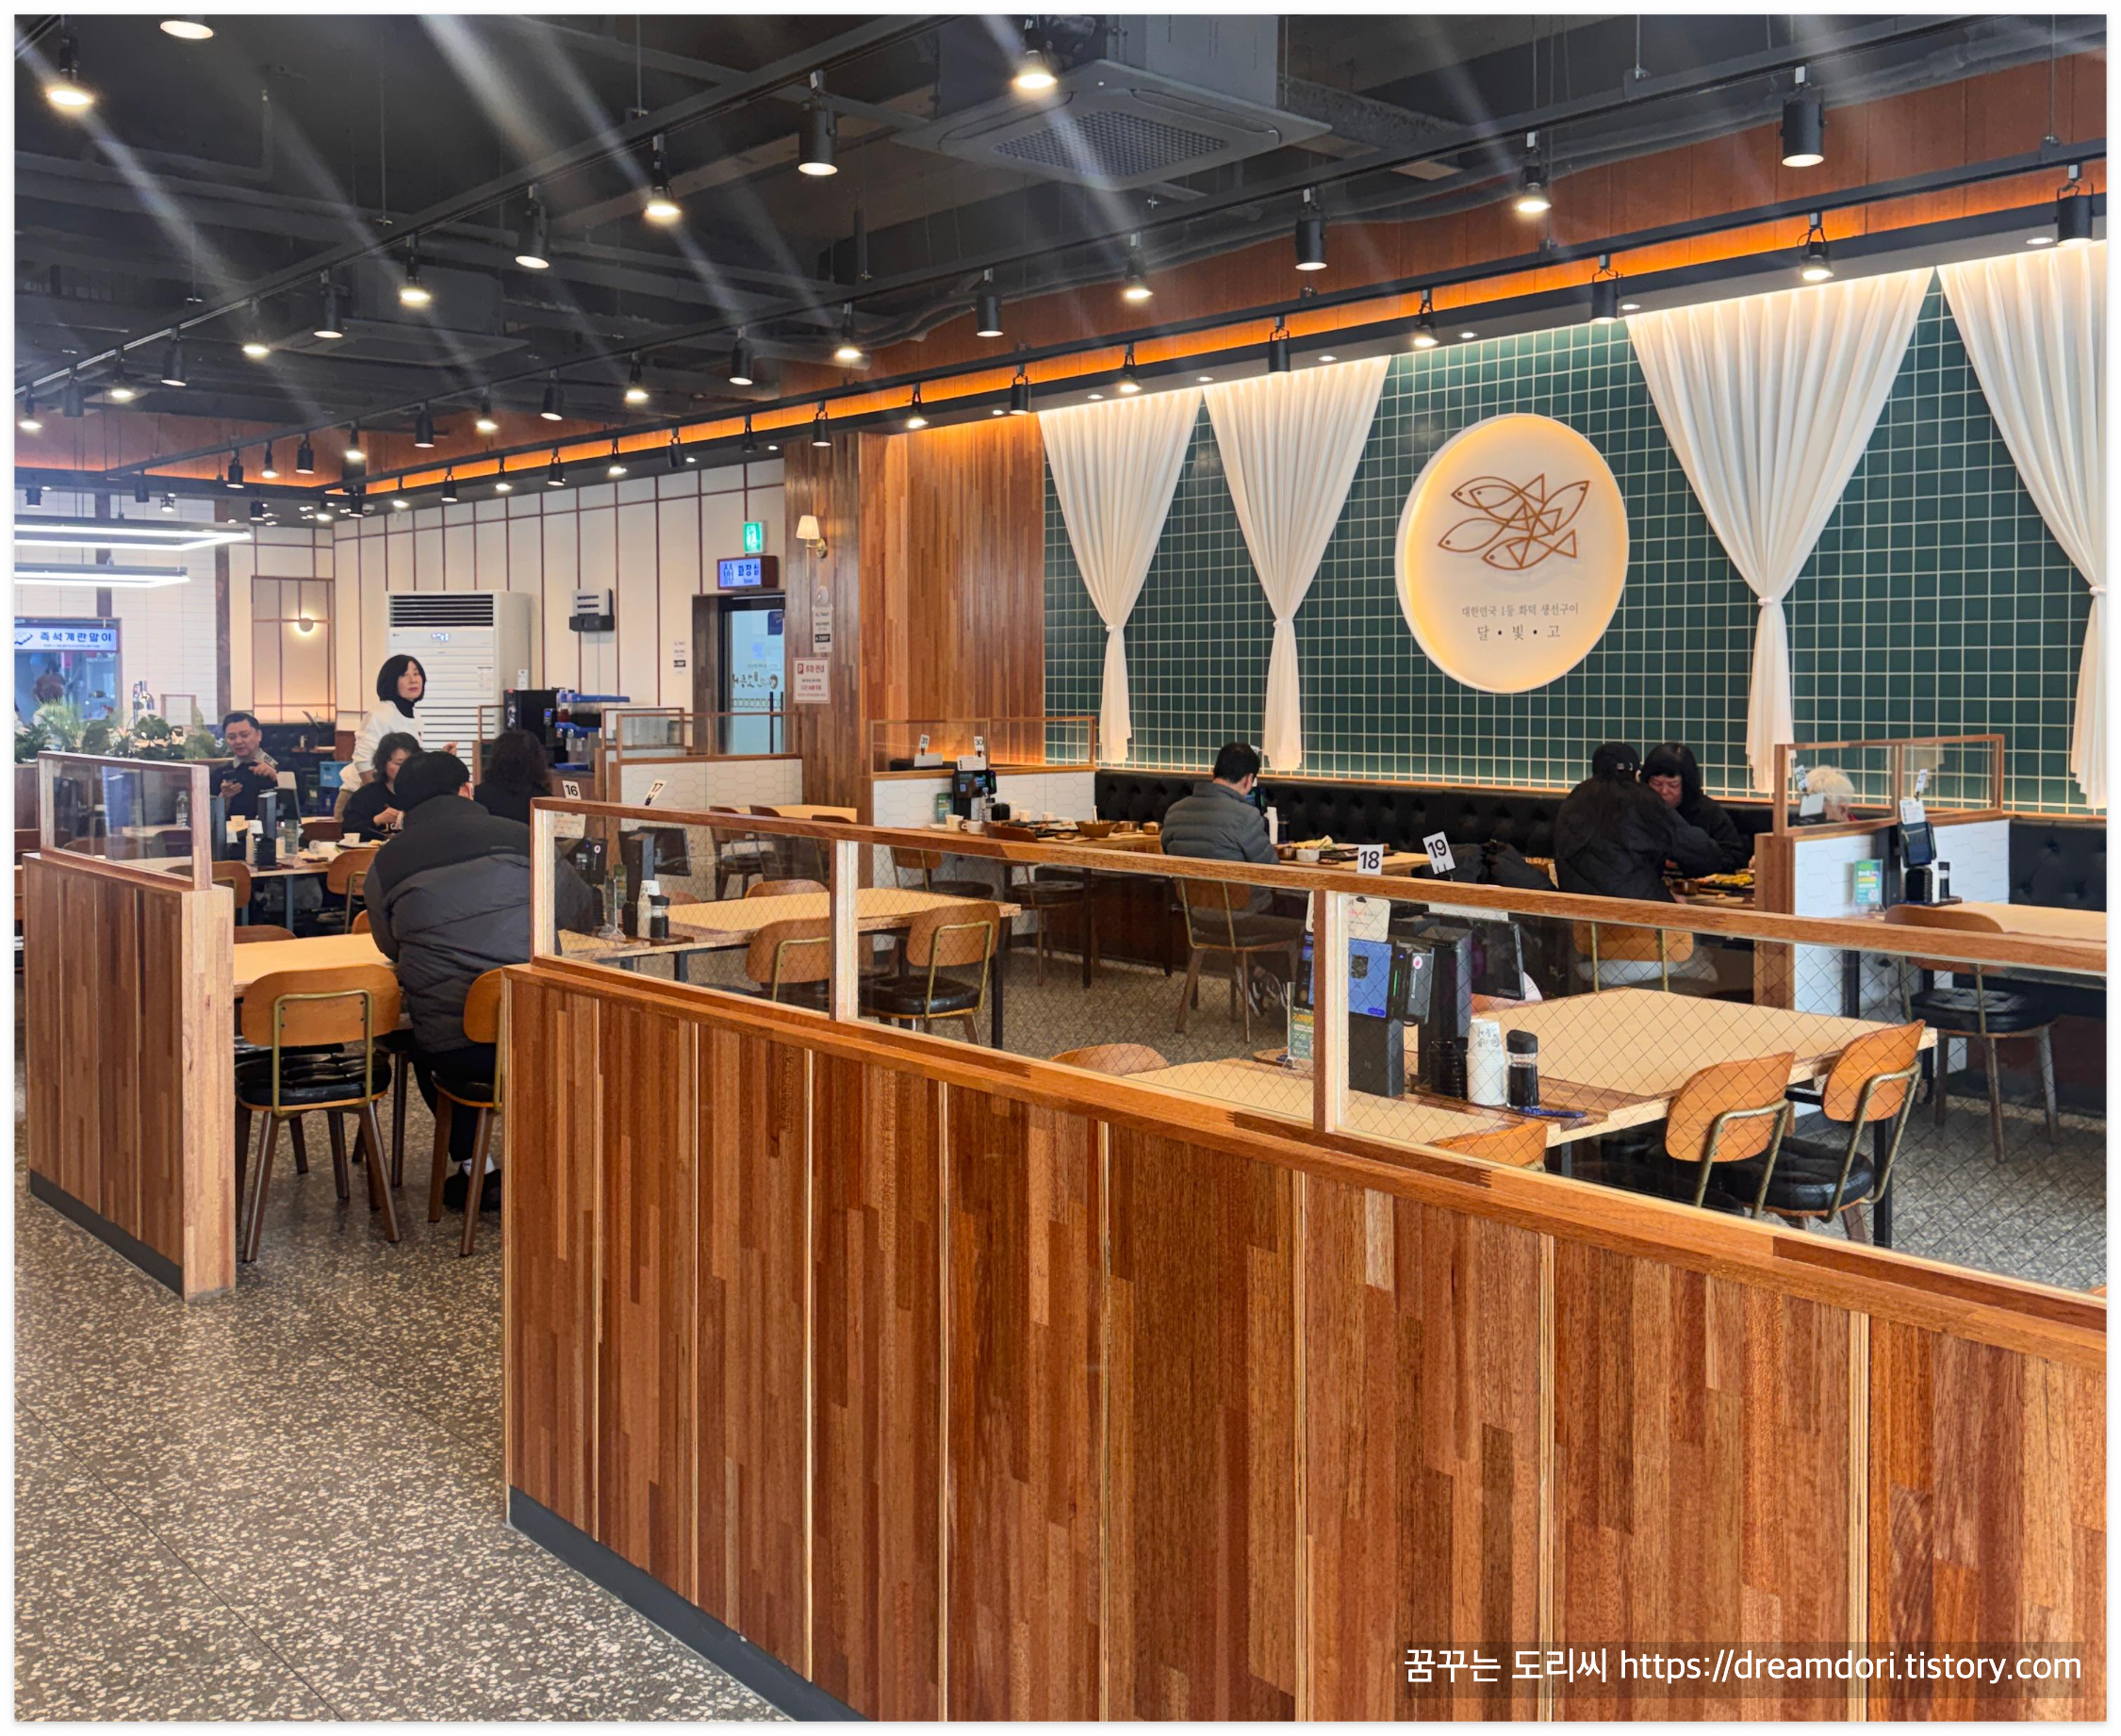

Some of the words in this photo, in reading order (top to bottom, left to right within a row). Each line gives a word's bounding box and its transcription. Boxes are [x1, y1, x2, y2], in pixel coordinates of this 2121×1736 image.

[1462, 605, 1497, 617] 대한민국
[1501, 605, 1515, 617] 1등
[1519, 604, 1537, 617] 화덕
[1541, 602, 1578, 616] 생선구이
[1477, 625, 1489, 641] 달
[1512, 624, 1524, 641] 빛
[1547, 625, 1560, 637] 고
[565, 784, 579, 796] 16
[651, 782, 664, 793] 17
[1427, 839, 1447, 859] 19
[1360, 850, 1380, 869] 18
